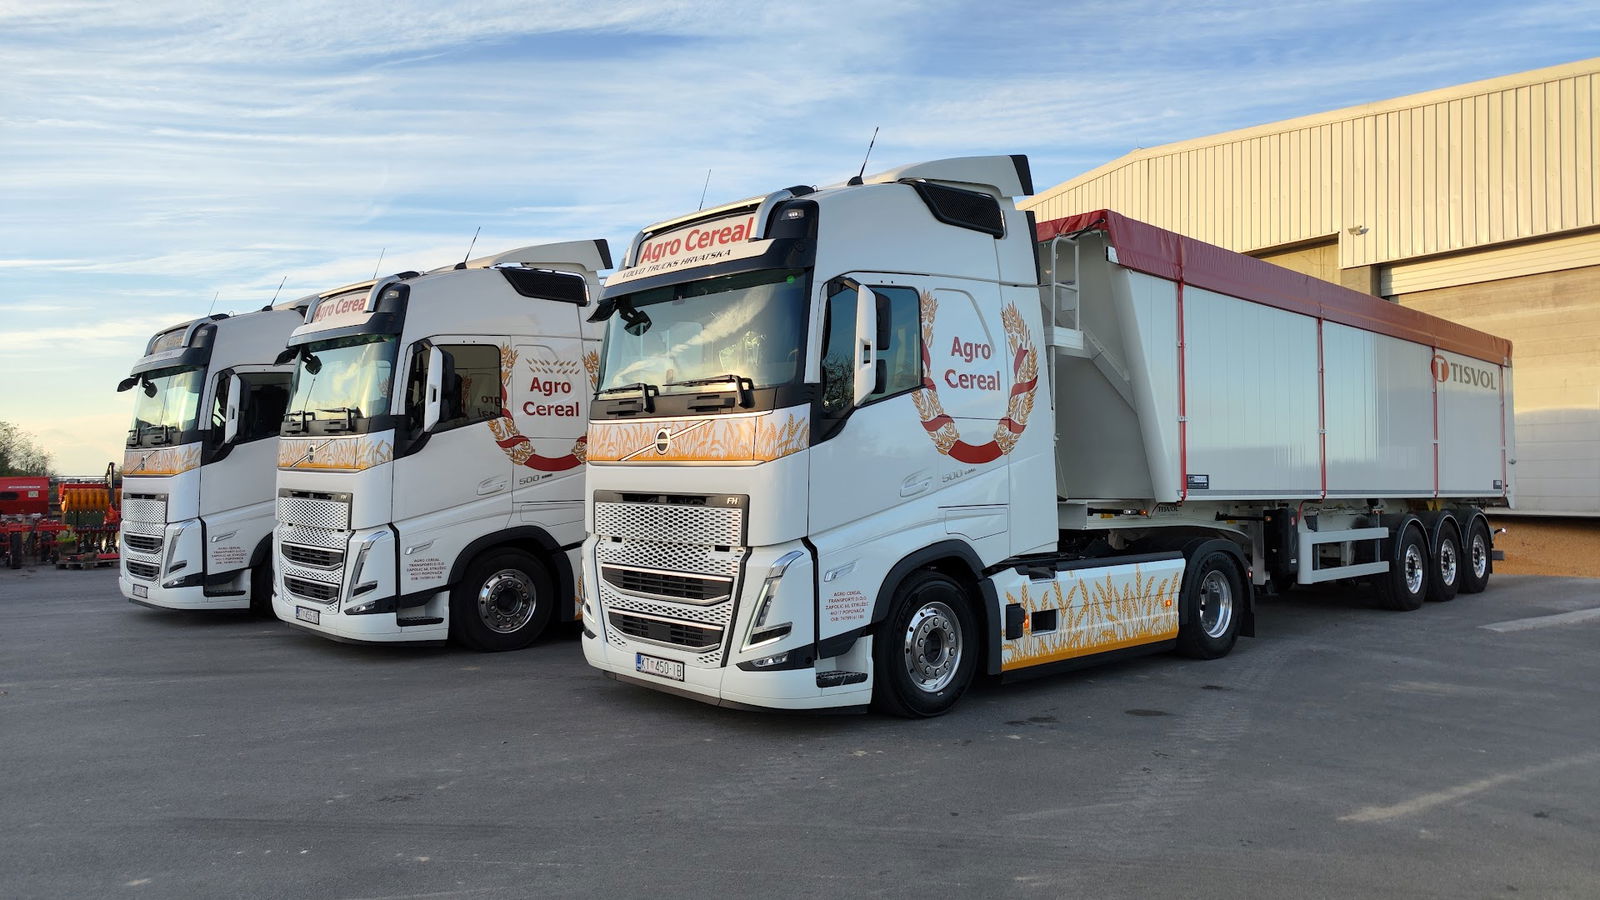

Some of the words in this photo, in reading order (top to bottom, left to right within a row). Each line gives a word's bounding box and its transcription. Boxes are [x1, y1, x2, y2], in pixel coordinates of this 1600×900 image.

[640, 238, 682, 264] Agro
[685, 217, 755, 252] Cereal
[622, 267, 647, 279] VOLVO
[648, 259, 679, 275] TRUCKS
[681, 249, 731, 265] HRVATSKA
[313, 304, 335, 322] Agro
[335, 298, 367, 315] Cerea
[951, 336, 991, 363] Agro
[530, 376, 572, 397] Agro
[944, 368, 1001, 391] Cereal
[1450, 362, 1497, 391] TISVOL
[522, 401, 580, 417] Cereal
[519, 474, 540, 485] 500
[726, 497, 740, 505] FH
